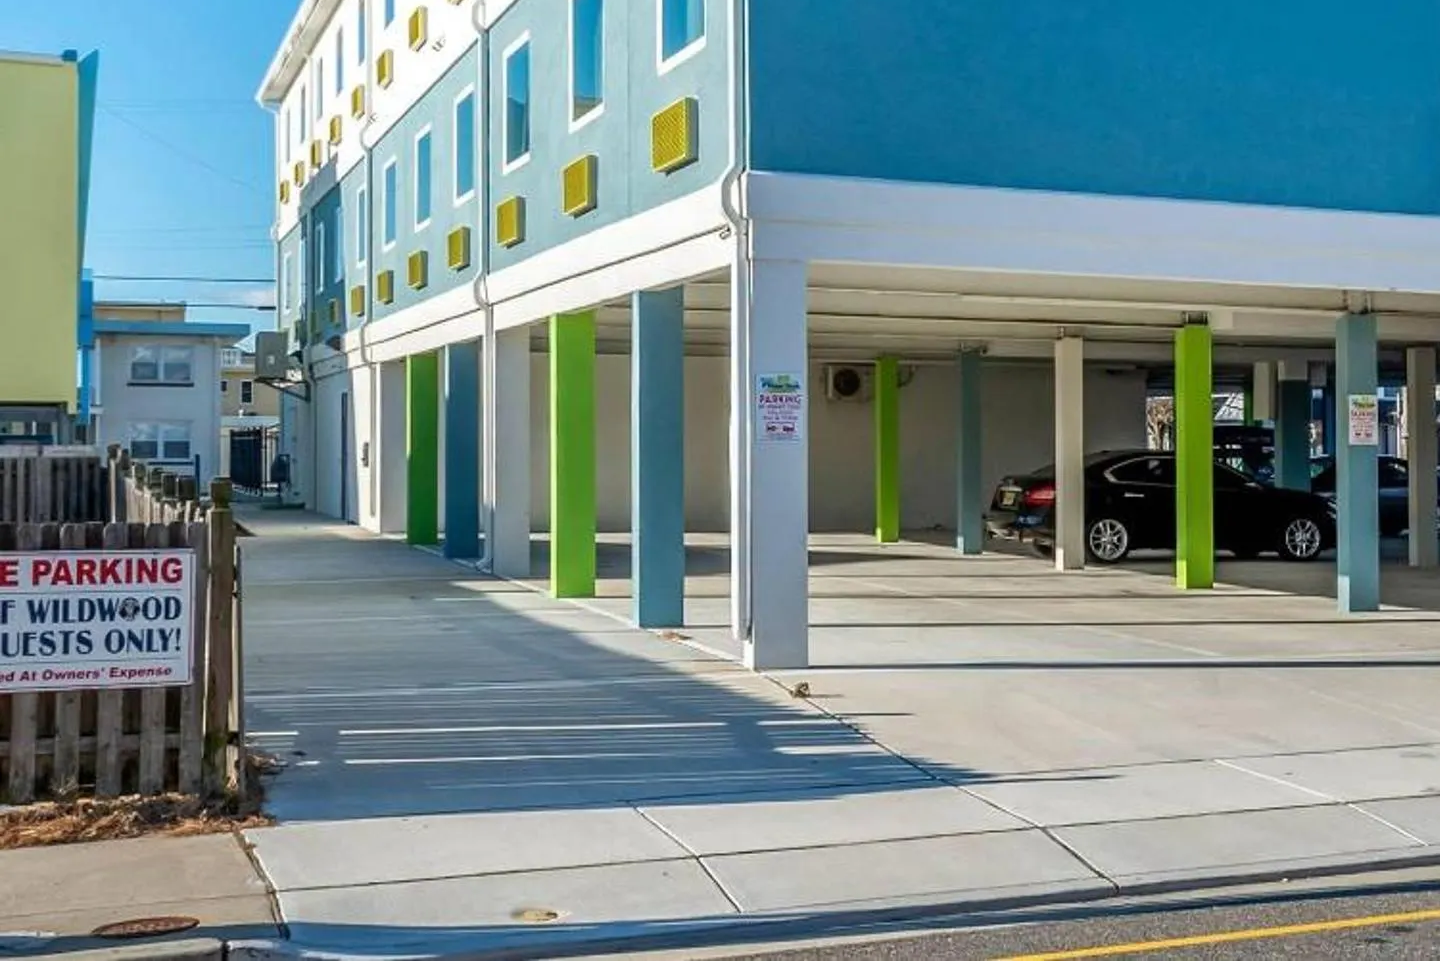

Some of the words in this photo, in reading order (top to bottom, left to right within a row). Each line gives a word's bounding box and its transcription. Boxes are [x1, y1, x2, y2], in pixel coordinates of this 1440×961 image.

[32, 557, 183, 586] PARKING
[104, 628, 181, 654] ONLY!
[20, 670, 36, 681] At
[42, 667, 105, 681] Owners'
[109, 666, 172, 679] Expense
